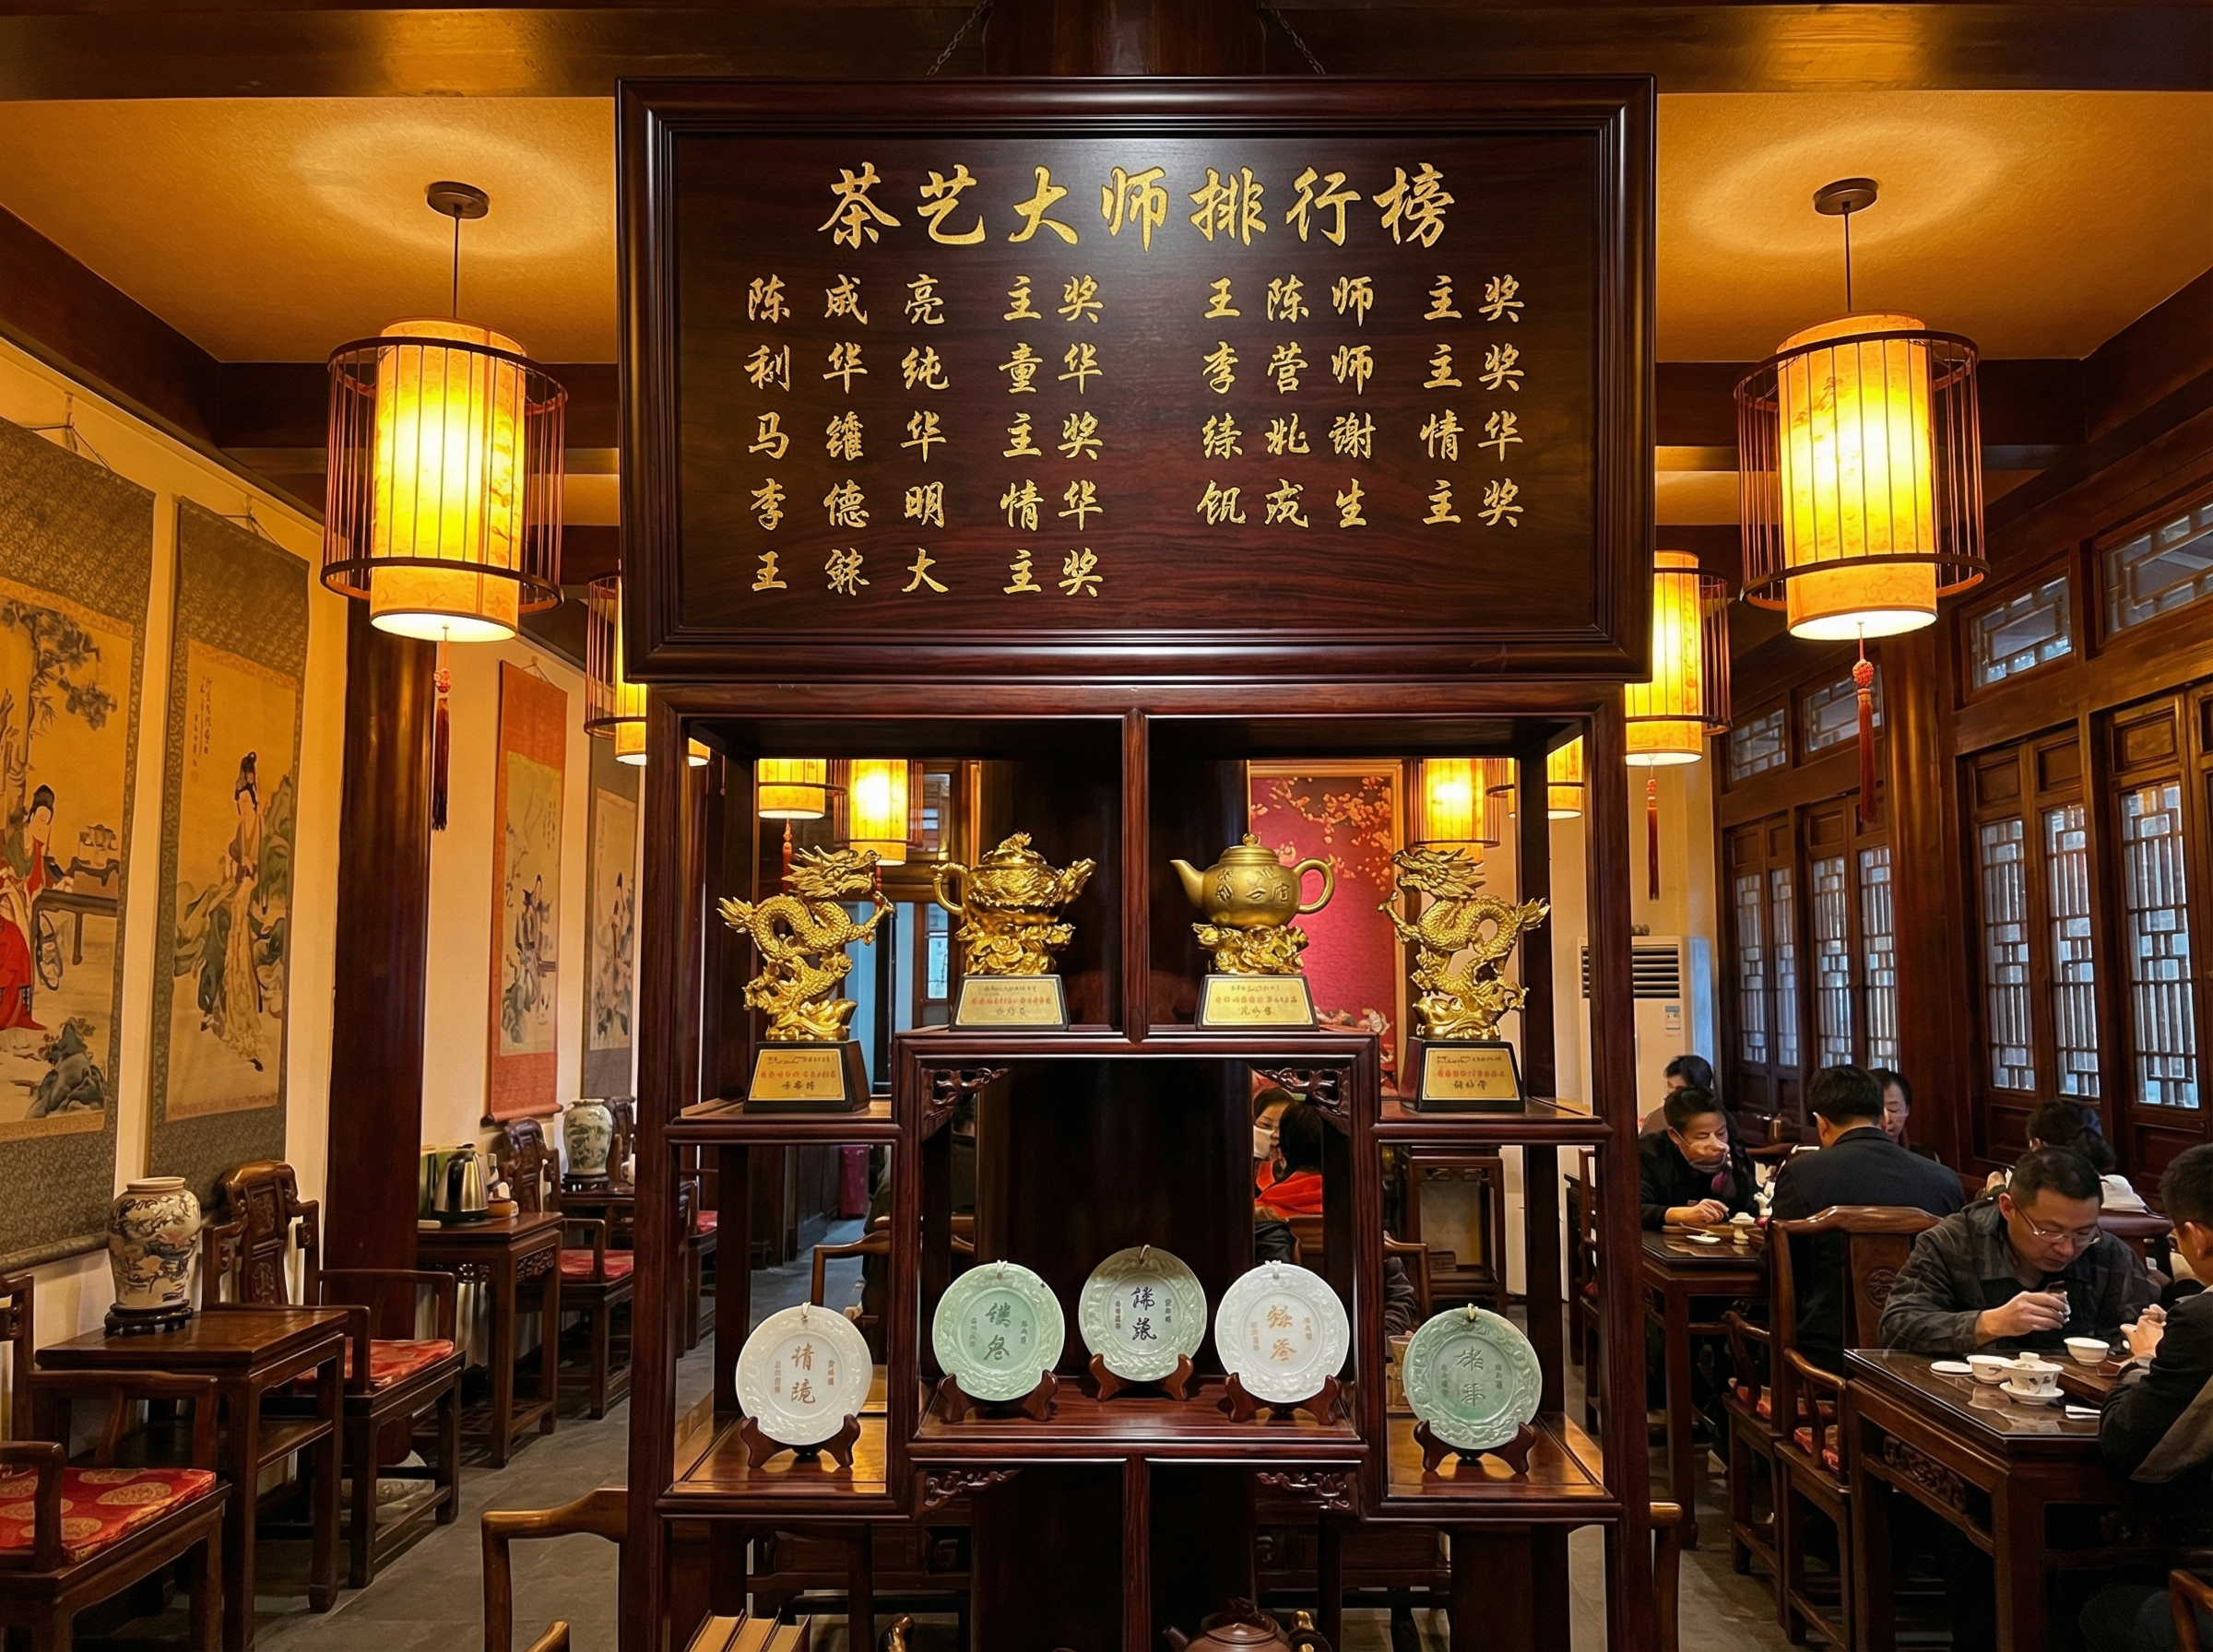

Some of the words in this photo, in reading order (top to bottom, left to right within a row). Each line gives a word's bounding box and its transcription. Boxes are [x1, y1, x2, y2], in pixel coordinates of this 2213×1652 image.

[818, 160, 1455, 253] 茶艺大师排行榜
[1003, 274, 1104, 324] 主奖
[1204, 274, 1374, 326] 王陈师
[1423, 273, 1525, 324] 主奖
[1202, 341, 1374, 395] 李营师
[1423, 342, 1525, 393] 主奖
[1002, 411, 1104, 461] 主奖
[750, 478, 945, 531] 李德明
[1423, 478, 1524, 528] 主奖
[1003, 549, 1104, 597] 主奖
